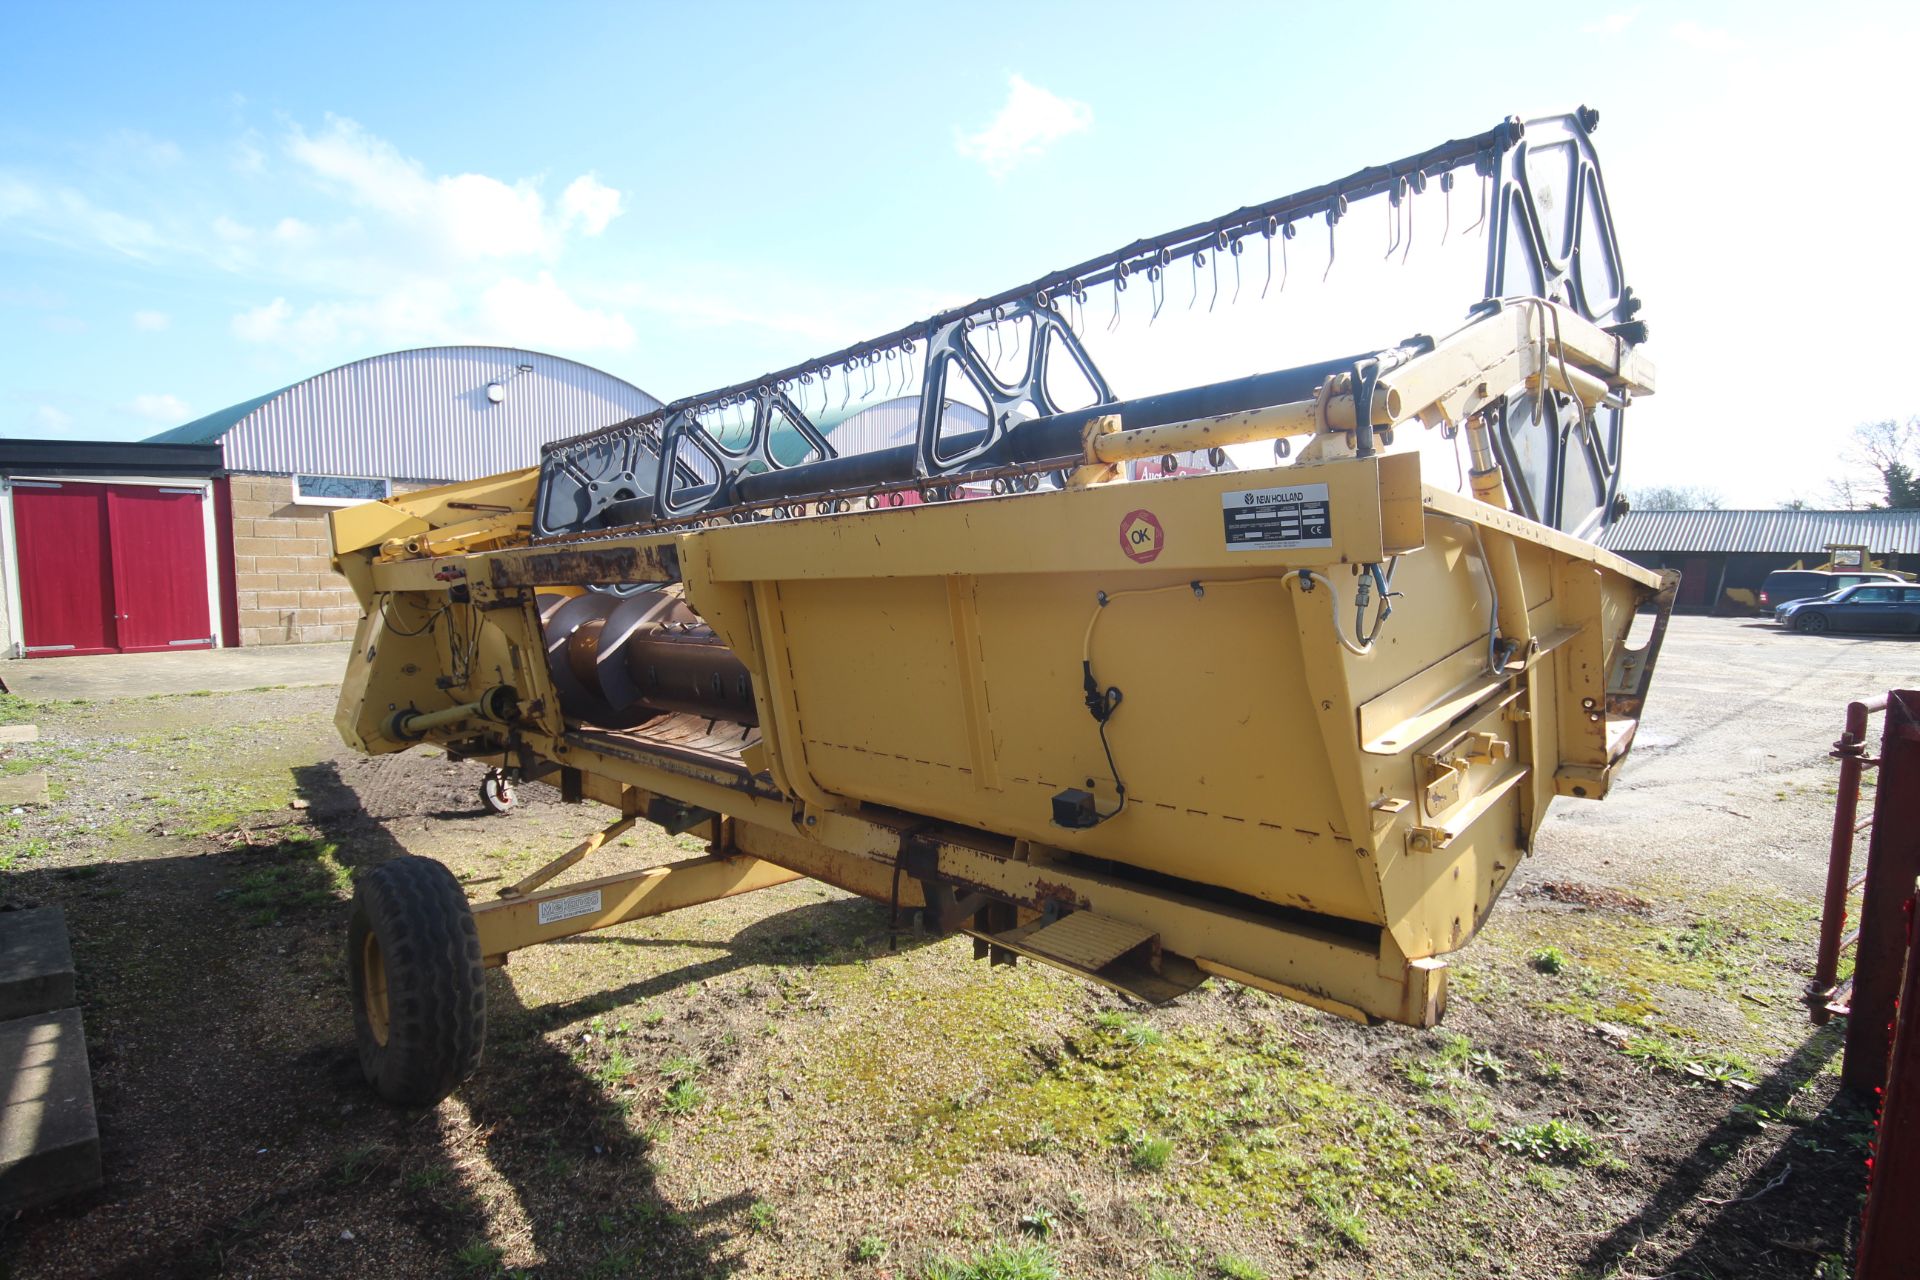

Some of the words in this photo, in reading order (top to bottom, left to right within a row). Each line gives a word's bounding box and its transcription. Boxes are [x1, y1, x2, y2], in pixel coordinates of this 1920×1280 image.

[1256, 495, 1271, 504] NEW
[1271, 492, 1304, 503] HOLLAND
[1131, 528, 1151, 545] OK
